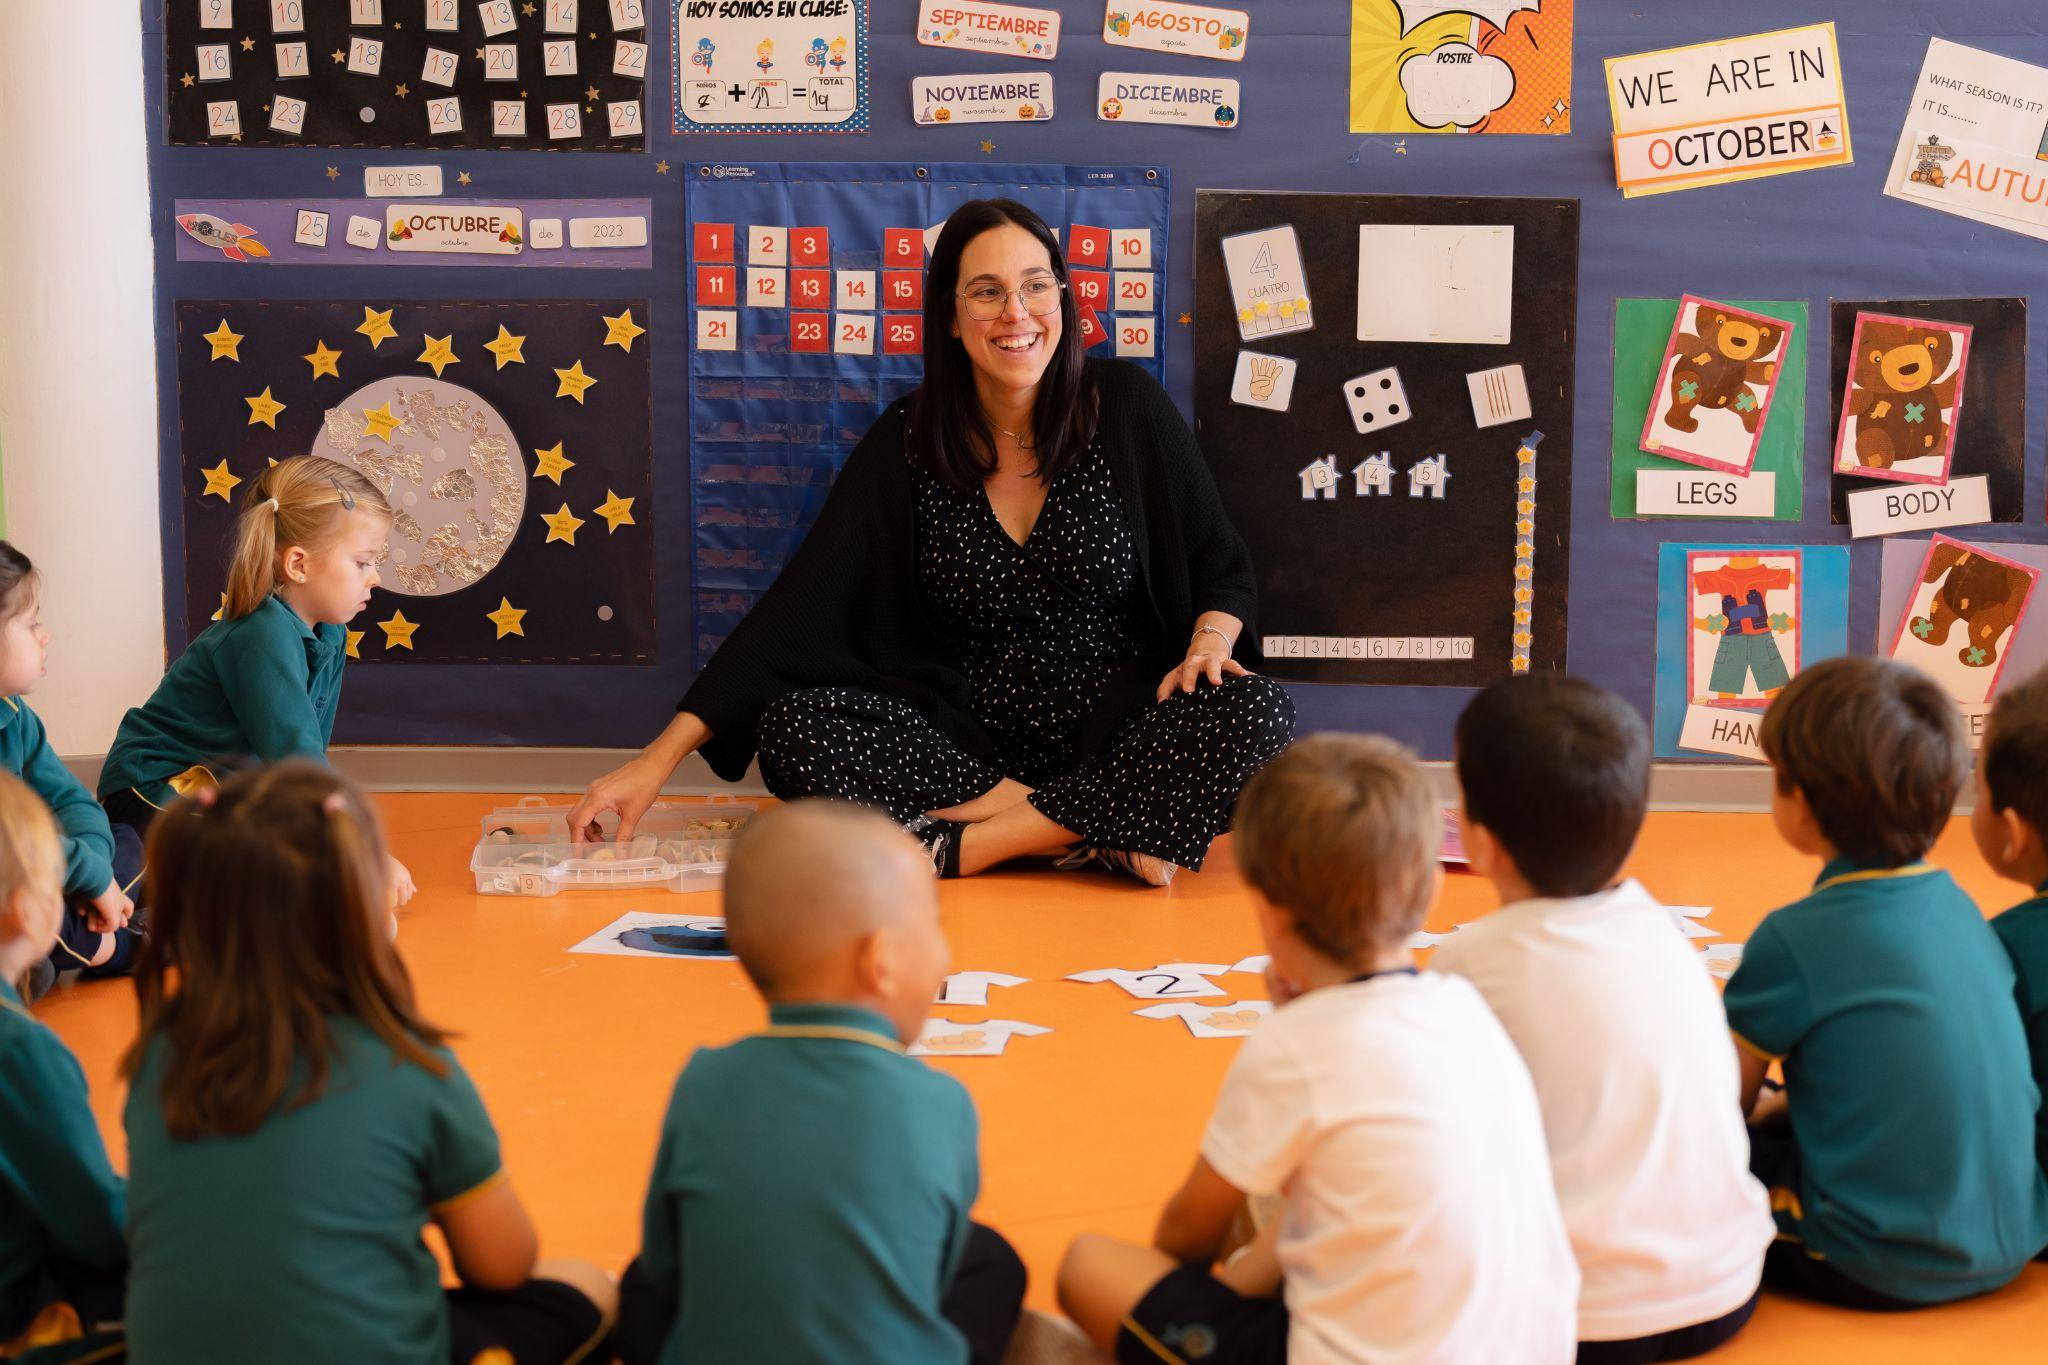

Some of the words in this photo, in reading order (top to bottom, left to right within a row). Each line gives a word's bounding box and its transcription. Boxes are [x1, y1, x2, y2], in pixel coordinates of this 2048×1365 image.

[210, 0, 221, 20] 9
[277, 2, 299, 23] 10
[358, 0, 376, 16] 11
[432, 0, 454, 22] 12
[486, 2, 511, 26] 13
[551, 2, 573, 23] 14
[616, 0, 639, 21] 15
[687, 1, 715, 17] HOY
[719, 1, 773, 18] SOMOS
[777, 1, 796, 17] EN
[800, 0, 848, 17] CLASE:
[929, 9, 1049, 37] SEPTIEMBRE
[1131, 11, 1222, 36] AGOSTO
[965, 33, 1009, 46] septiembre
[1160, 39, 1187, 48] agosto
[204, 49, 227, 71] 16
[281, 47, 303, 68] 17
[355, 43, 378, 65] 18
[489, 48, 514, 70] 20
[548, 45, 571, 67] 21
[618, 45, 643, 69] 22
[1436, 52, 1473, 64] POSTRE
[431, 54, 454, 77] 19
[696, 81, 717, 89] NIÑOS
[819, 78, 844, 86] TOTAL
[1619, 70, 1678, 109] WE
[1706, 54, 1774, 97] ARE
[1789, 46, 1825, 83] IN
[926, 83, 1040, 102] NOVIEMBRE
[1116, 84, 1223, 105] DICIEMBRE
[1929, 73, 1965, 92] WHAT
[1965, 84, 2011, 106] SEASON
[2013, 97, 2024, 109] IS
[2025, 101, 2043, 114] IT?
[275, 100, 301, 124] 23
[431, 101, 457, 125] 26
[961, 105, 1006, 115] noviembre
[1148, 106, 1188, 117] diciembre
[1922, 99, 1936, 111] IT
[211, 105, 236, 127] 24
[497, 105, 522, 126] 27
[551, 108, 577, 130] 28
[613, 105, 637, 128] 29
[1648, 120, 1810, 170] OCTOBER
[378, 174, 402, 187] HOY
[1950, 159, 2048, 206] AUTU
[299, 214, 324, 237] 25
[355, 224, 371, 238] de
[409, 215, 501, 234] OCTUBRE
[538, 227, 554, 239] de
[593, 224, 624, 238] 2023
[440, 238, 469, 247] octubre
[710, 233, 718, 250] 1
[762, 236, 774, 253] 2
[803, 237, 816, 254] 3
[897, 238, 910, 255] 5
[1081, 238, 1095, 256] 9
[1120, 238, 1141, 256] 10
[1250, 241, 1279, 279] 4
[708, 276, 724, 294] 11
[757, 278, 775, 295] 12
[800, 280, 820, 296] 13
[846, 281, 866, 297] 14
[892, 280, 913, 297] 15
[1079, 281, 1099, 298] 19
[1121, 281, 1147, 299] 20
[1247, 281, 1290, 299] CUATRO
[708, 321, 727, 338] 21
[797, 322, 822, 340] 23
[842, 324, 867, 341] 24
[890, 324, 915, 342] 25
[1080, 318, 1094, 335] 9
[1122, 328, 1149, 345] 30
[1318, 469, 1328, 484] 3
[1369, 467, 1378, 482] 4
[1422, 466, 1431, 481] 5
[1677, 482, 1737, 505] LEGS
[1886, 488, 1955, 518] BODY
[1270, 639, 1276, 653] 1
[1290, 639, 1298, 654] 2
[1311, 640, 1320, 653] 3
[1331, 640, 1339, 655] 4
[1352, 640, 1361, 655] 5
[1373, 640, 1383, 656] 6
[1396, 640, 1405, 655] 7
[1416, 641, 1423, 654] 8
[1436, 640, 1445, 655] 9
[1455, 640, 1470, 655] 10
[1711, 719, 1759, 747] HAN
[1136, 974, 1199, 994] 2
